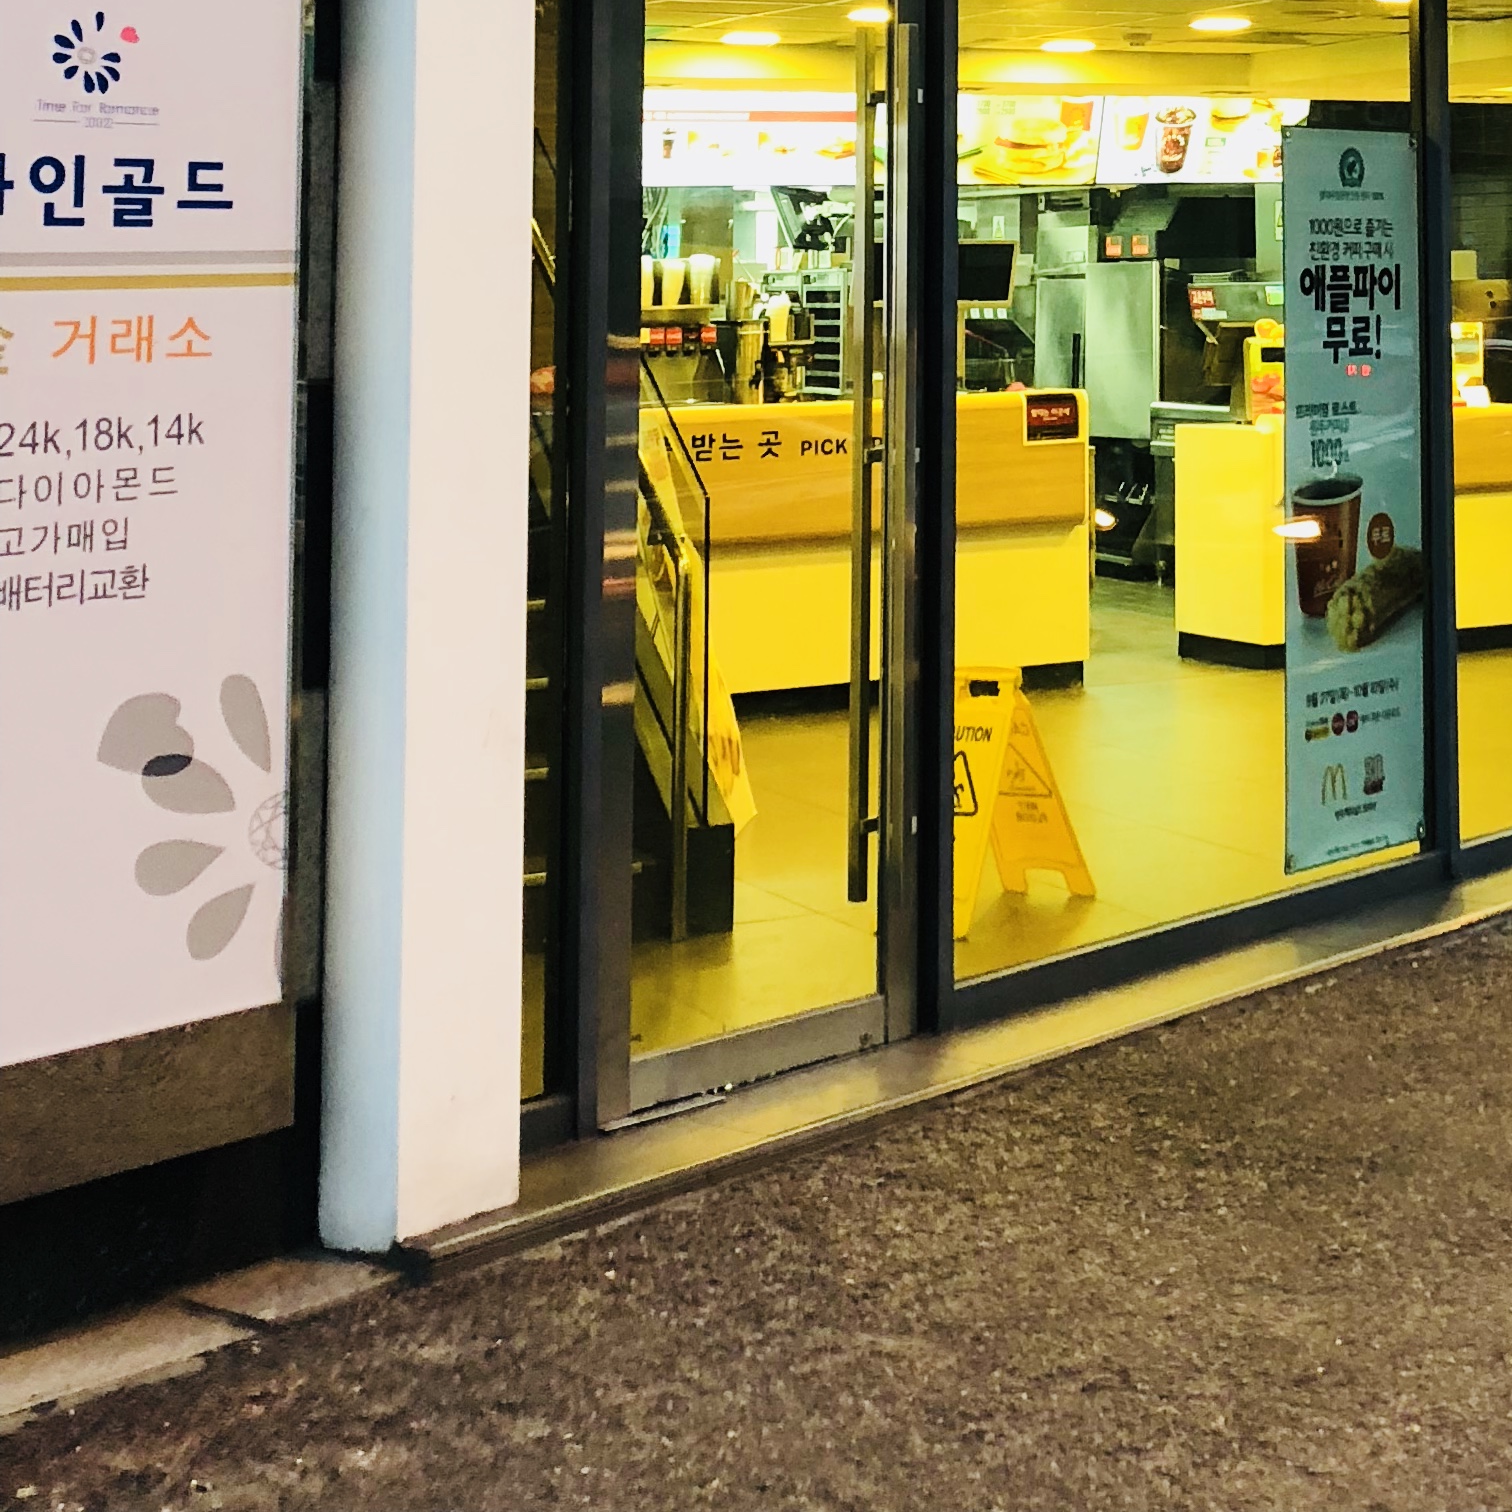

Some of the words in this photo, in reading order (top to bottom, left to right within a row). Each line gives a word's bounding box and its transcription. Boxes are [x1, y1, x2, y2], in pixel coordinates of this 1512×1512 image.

[1300, 263, 1401, 312] 애플파이
[51, 315, 213, 365] 거래소
[1322, 313, 1382, 365] 무료!
[0, 412, 205, 460] 24k,18k,14k
[691, 433, 743, 462] 받는
[757, 430, 782, 459] 곳
[800, 438, 848, 456] PICK
[0, 462, 179, 510] 다이아몬드
[0, 518, 129, 557] 고가매입
[0, 566, 149, 611] 배터리교환
[954, 726, 992, 742] UTION
